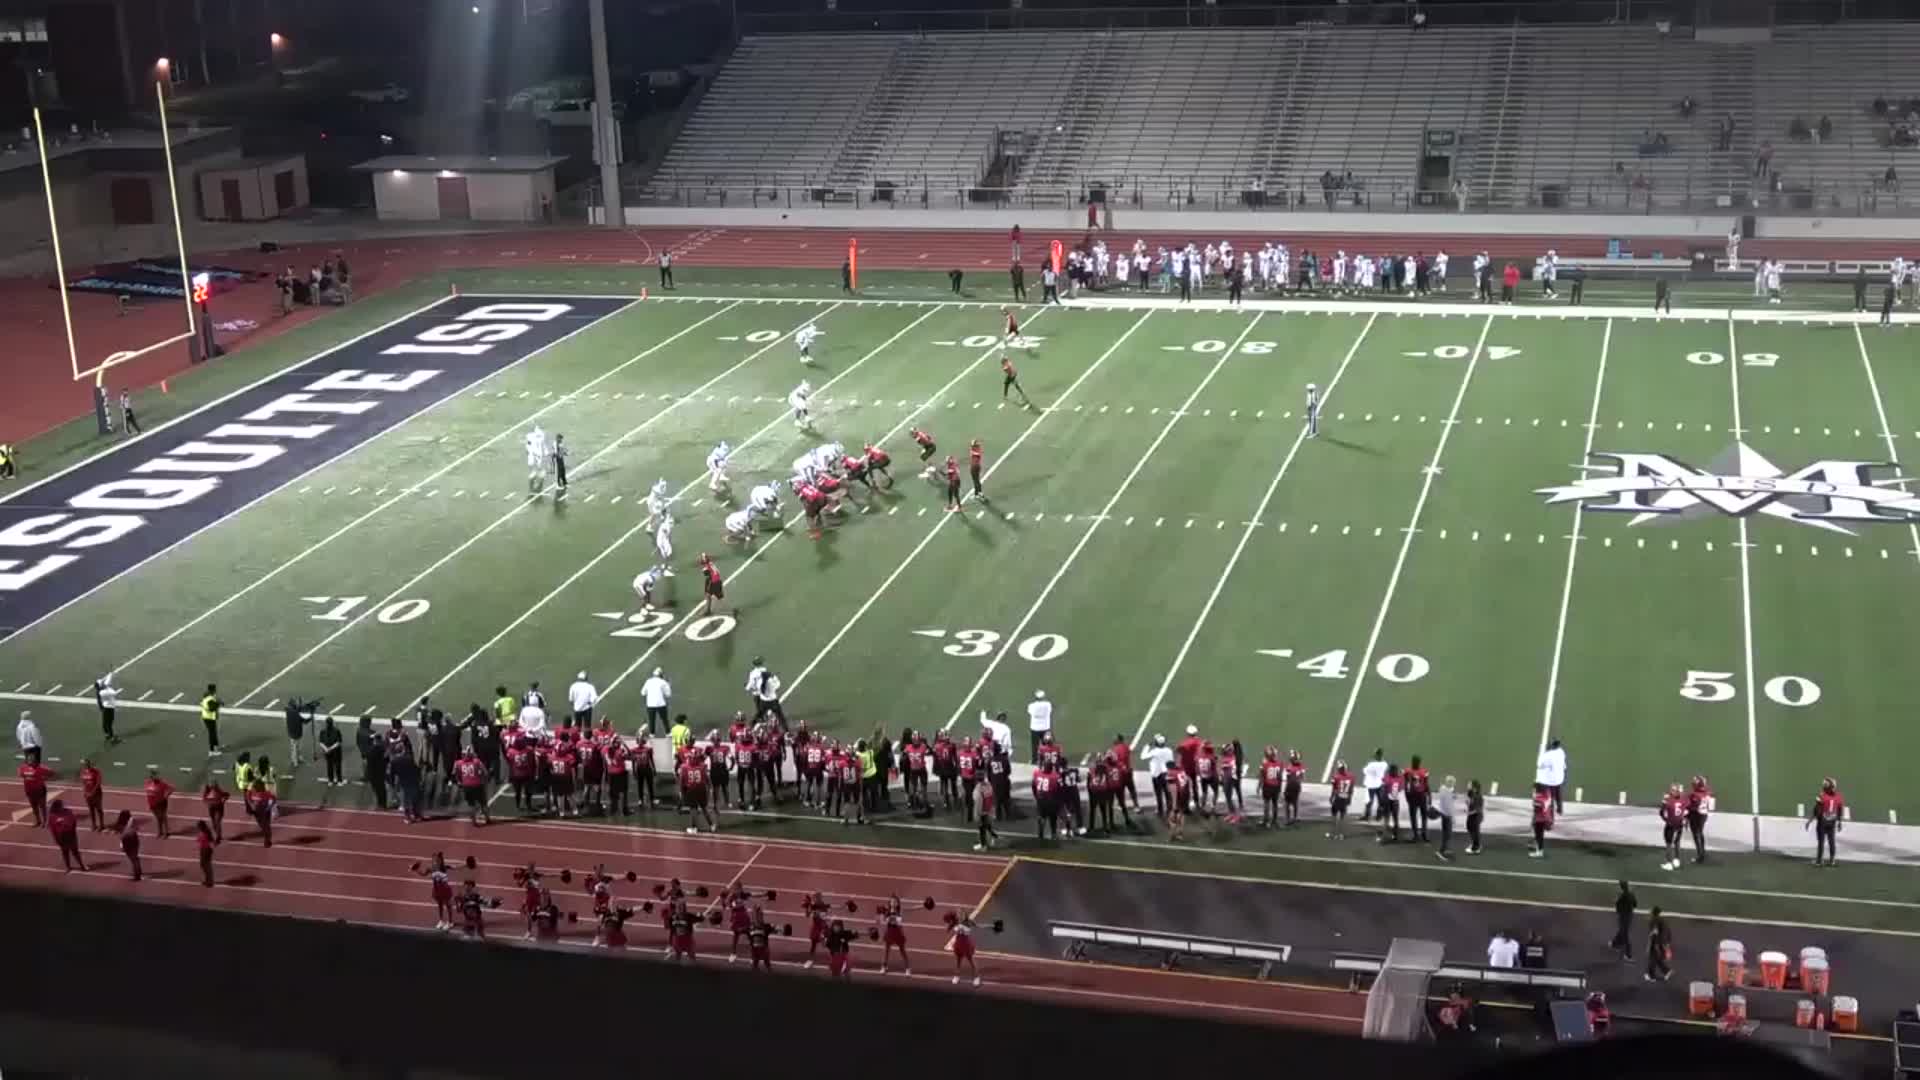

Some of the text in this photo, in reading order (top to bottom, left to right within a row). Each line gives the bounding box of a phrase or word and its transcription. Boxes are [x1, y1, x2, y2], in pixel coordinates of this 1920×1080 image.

[382, 302, 575, 355] ISD
[943, 629, 1069, 661] 30
[1297, 649, 1430, 683] 40
[1679, 670, 1822, 707] 50
